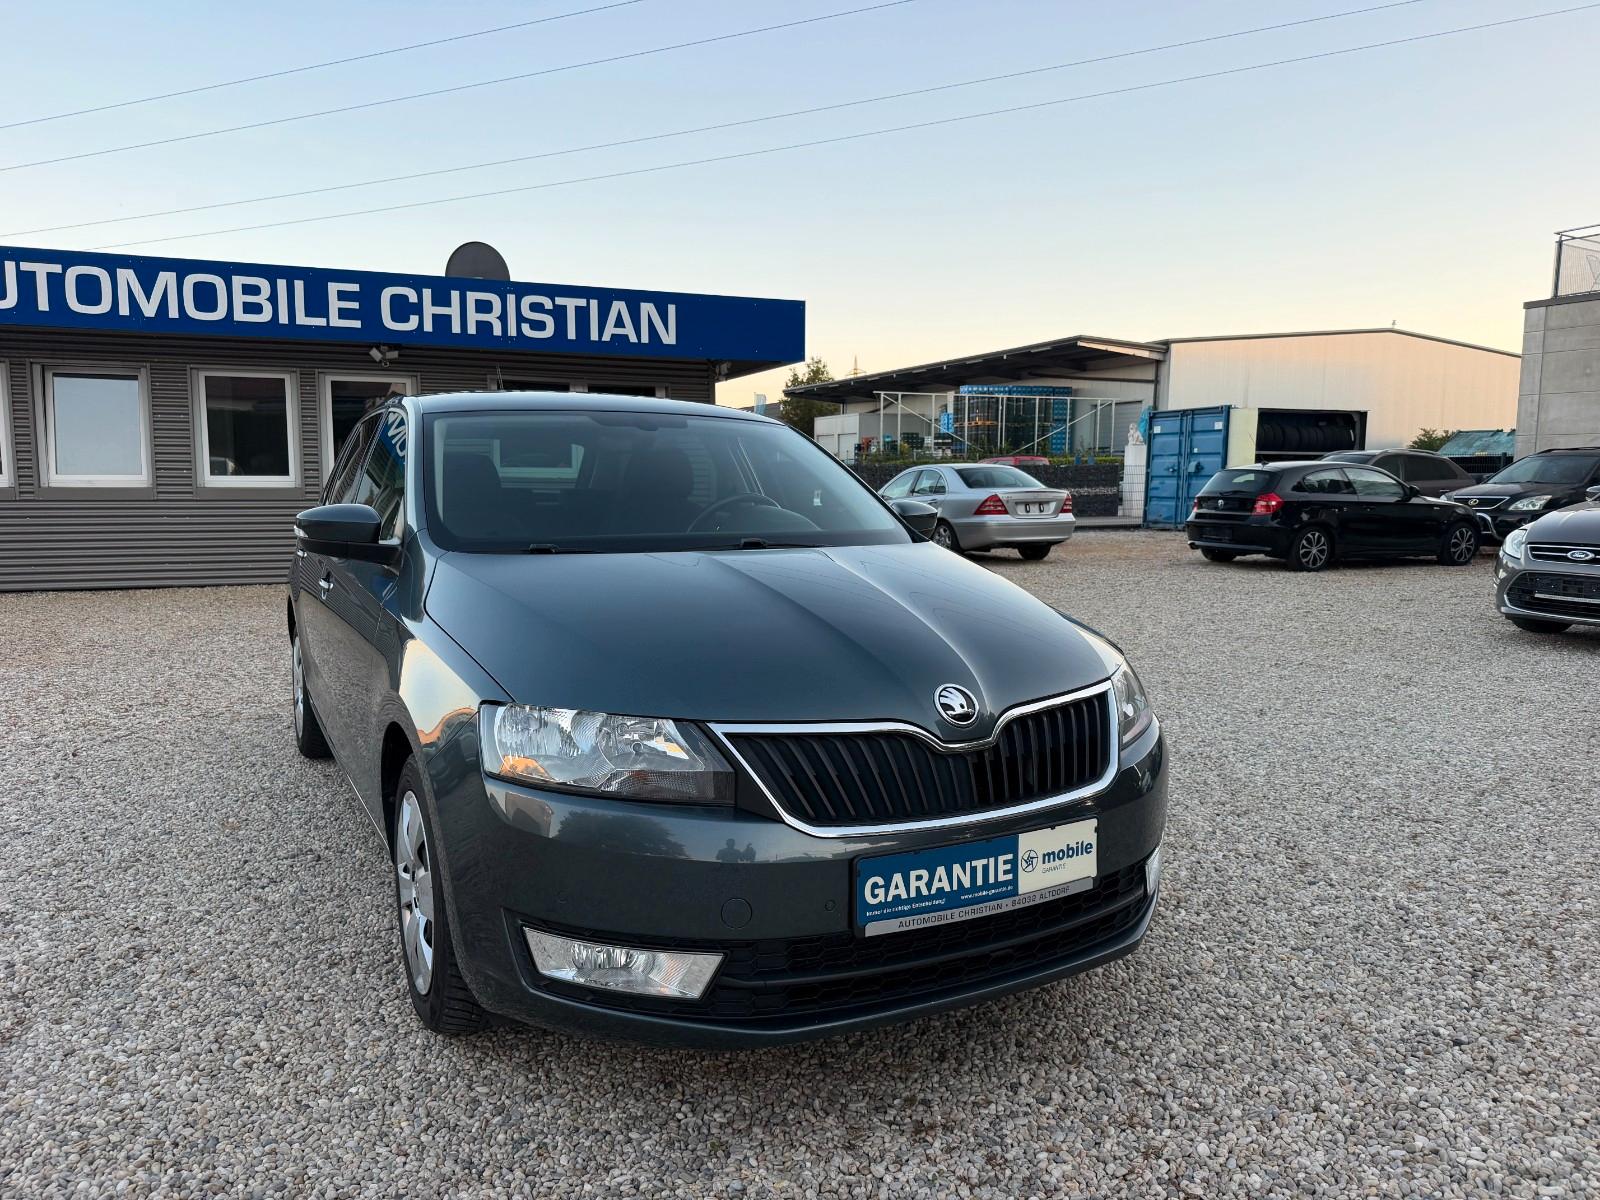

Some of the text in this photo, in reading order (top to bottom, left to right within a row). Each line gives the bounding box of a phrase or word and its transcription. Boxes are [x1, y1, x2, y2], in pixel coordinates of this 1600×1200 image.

[380, 286, 677, 346] CHRISTIAN
[1042, 840, 1093, 865] mobile
[864, 854, 1014, 905] GARANTIE
[898, 886, 1071, 929] AUTOMOBILE CHRISTIAN 84032 ALTDORF
